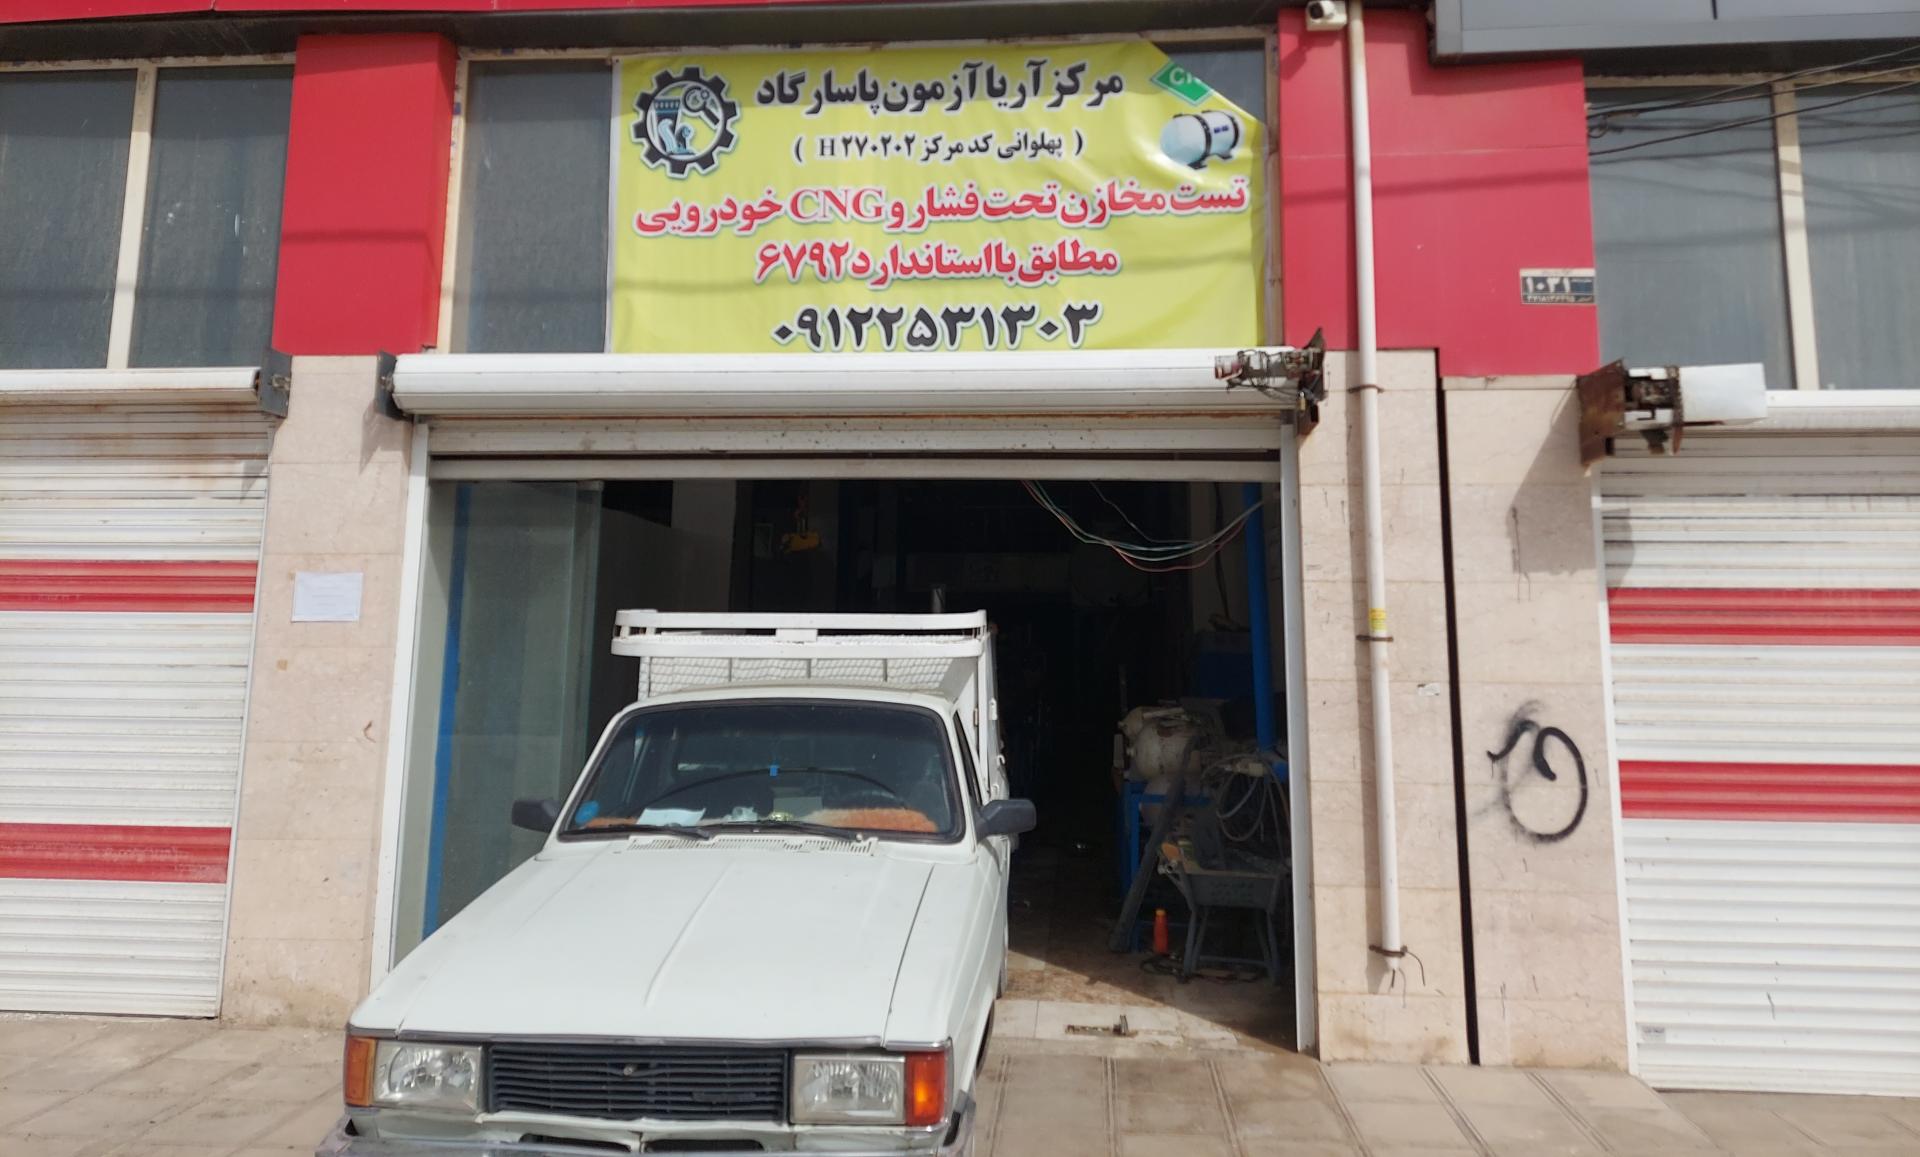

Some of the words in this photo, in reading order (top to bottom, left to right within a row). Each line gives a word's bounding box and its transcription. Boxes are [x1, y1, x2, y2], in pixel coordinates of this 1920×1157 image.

[757, 69, 879, 115] پاسارگاد
[883, 61, 983, 112] آزمون
[985, 59, 1048, 109] آریا
[1047, 62, 1123, 108] مرکز
[920, 135, 964, 161] مرکز
[968, 134, 993, 154] کد
[997, 131, 1063, 159] پهلوانی
[636, 189, 783, 232] خودرویی
[790, 188, 884, 219] CNG
[886, 201, 905, 229] و
[907, 182, 979, 228] فشار
[982, 183, 1057, 217] تحت
[1060, 180, 1166, 224] مخازن
[1171, 178, 1246, 211] تست
[756, 241, 850, 280] ۶۷۹۲
[851, 243, 993, 286] استاندارد
[990, 241, 1017, 282] با
[1018, 240, 1118, 283] مطابق
[774, 303, 1099, 348] ۰۹۱۲۲۵۳۱۳۰۳
